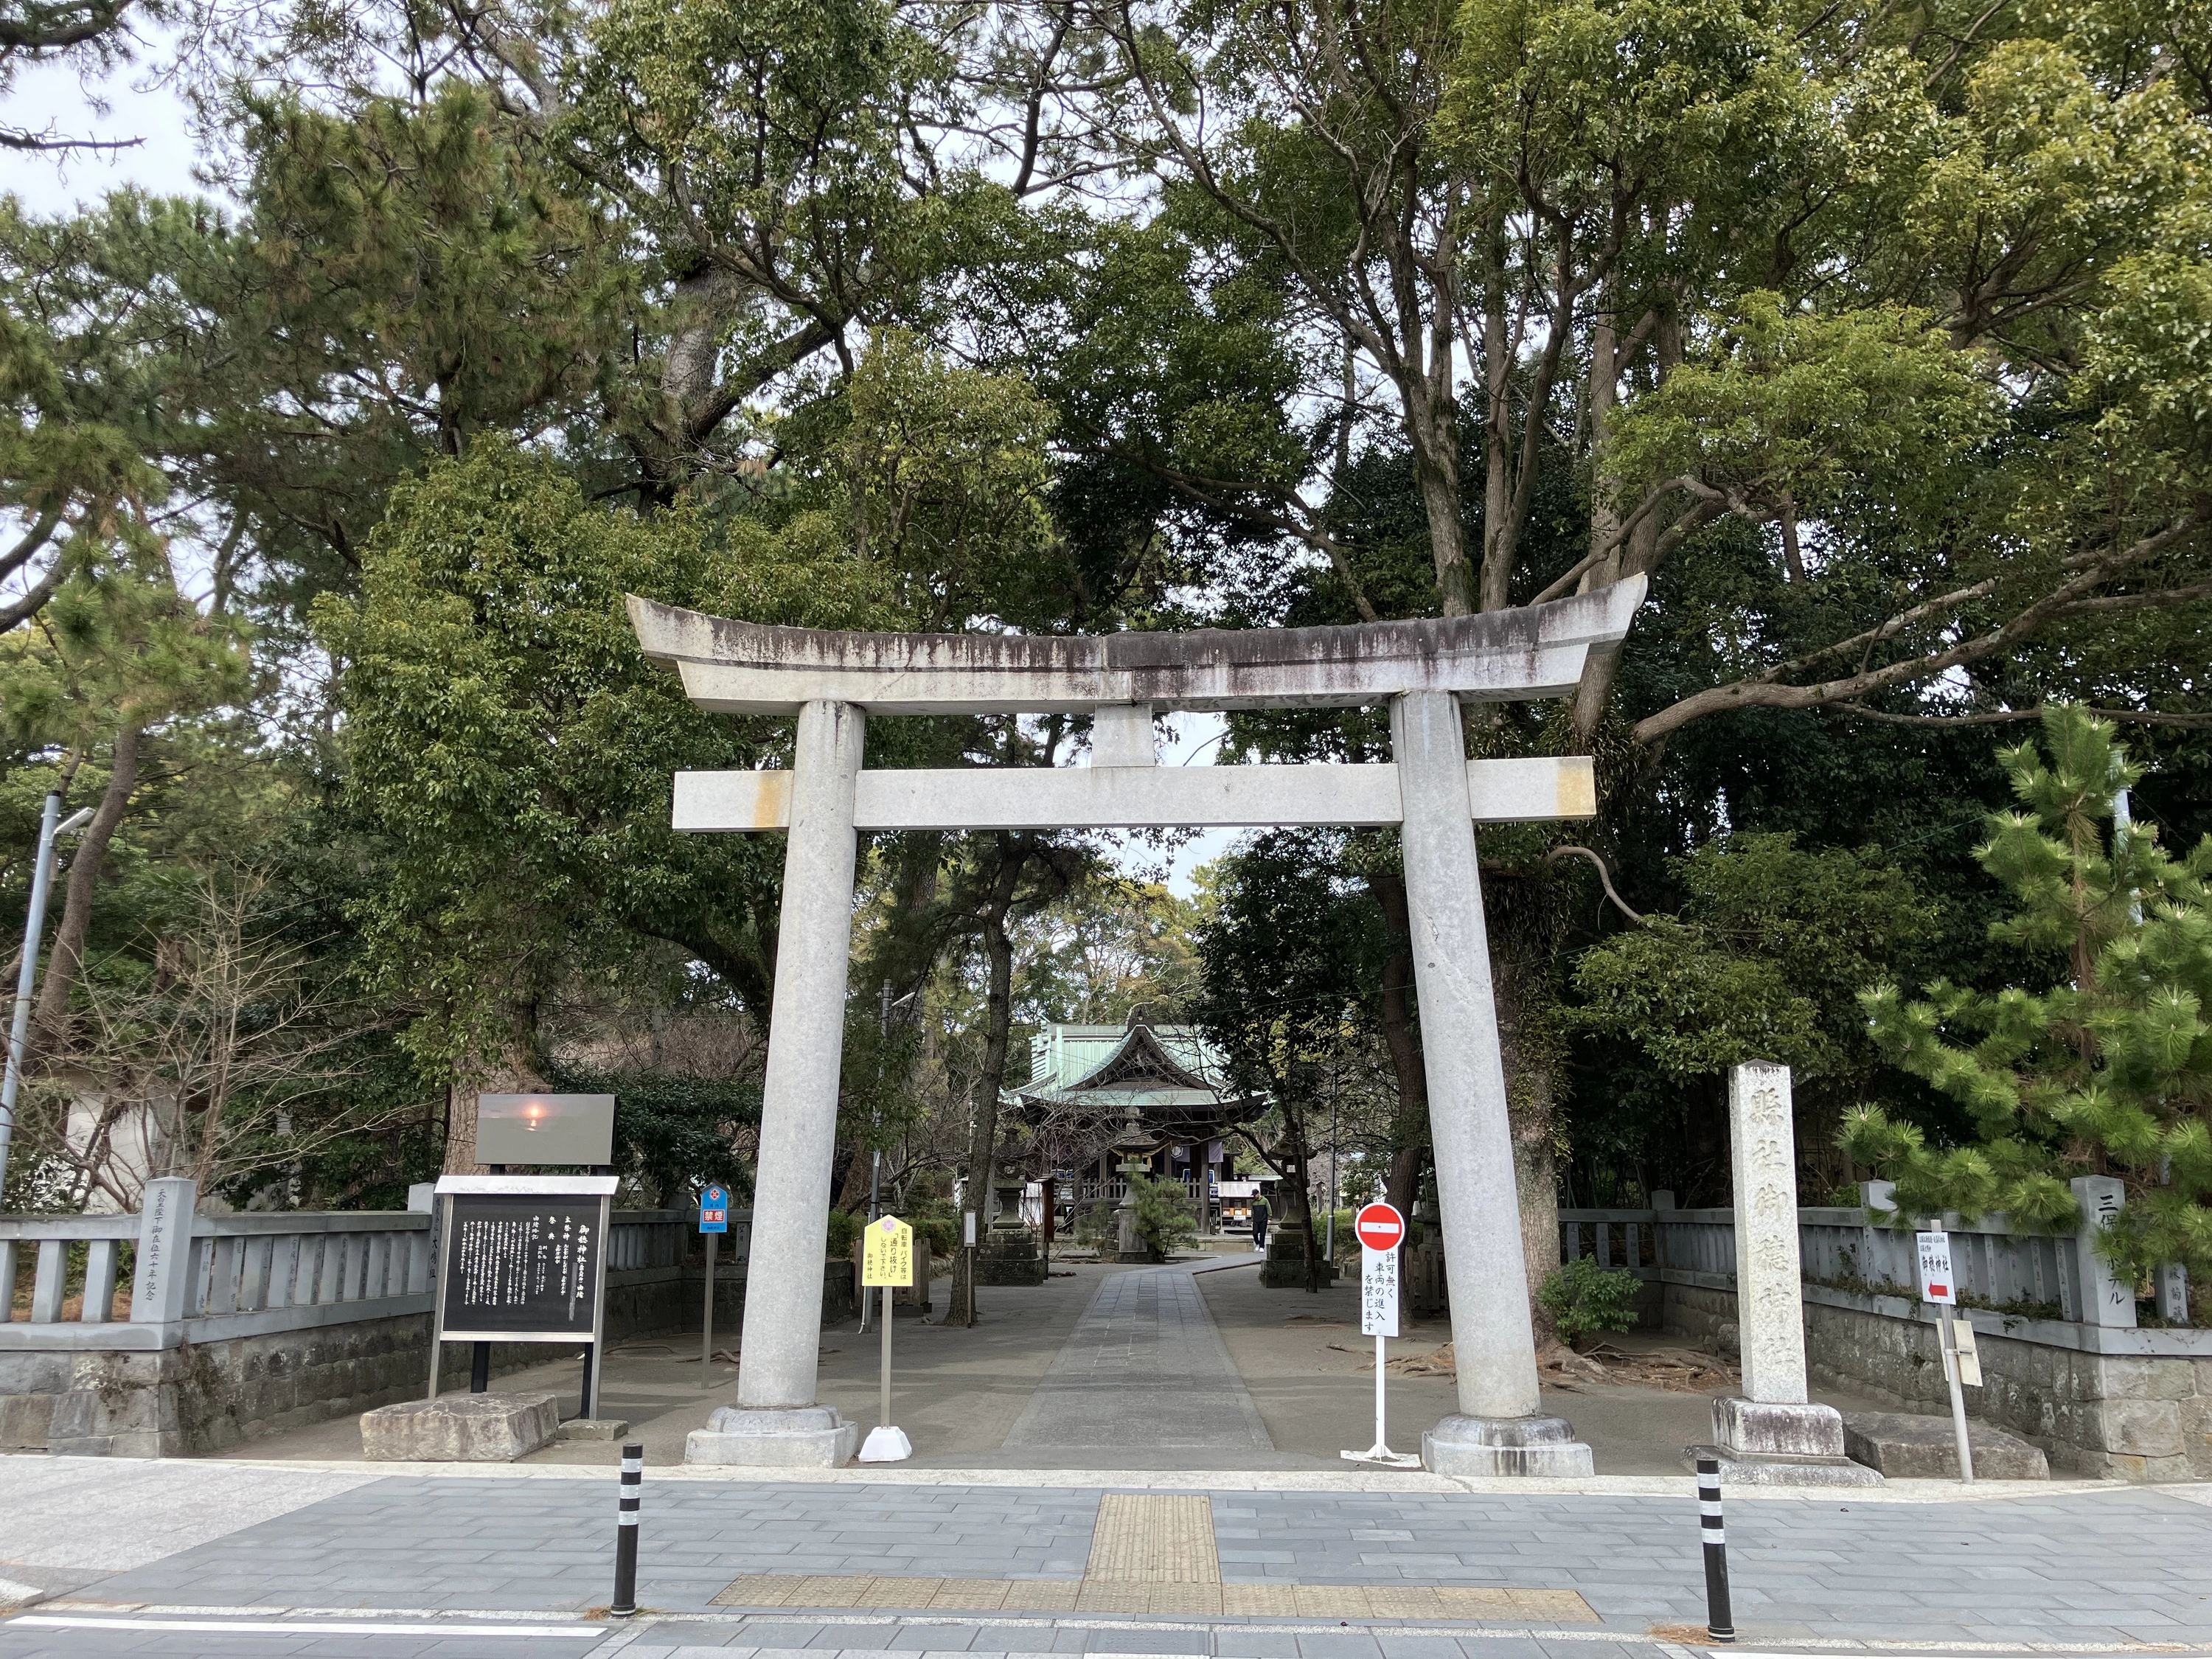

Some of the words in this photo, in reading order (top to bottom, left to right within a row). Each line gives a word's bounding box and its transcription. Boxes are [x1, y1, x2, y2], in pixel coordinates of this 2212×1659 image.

[145, 1189, 167, 1301] 天皇陛下御在位六十年記念
[704, 1211, 723, 1221] 禁煙
[1364, 1274, 1374, 1332] を禁じます
[1374, 1262, 1385, 1321] 車両の進入
[1385, 1252, 1396, 1298] 許可無く
